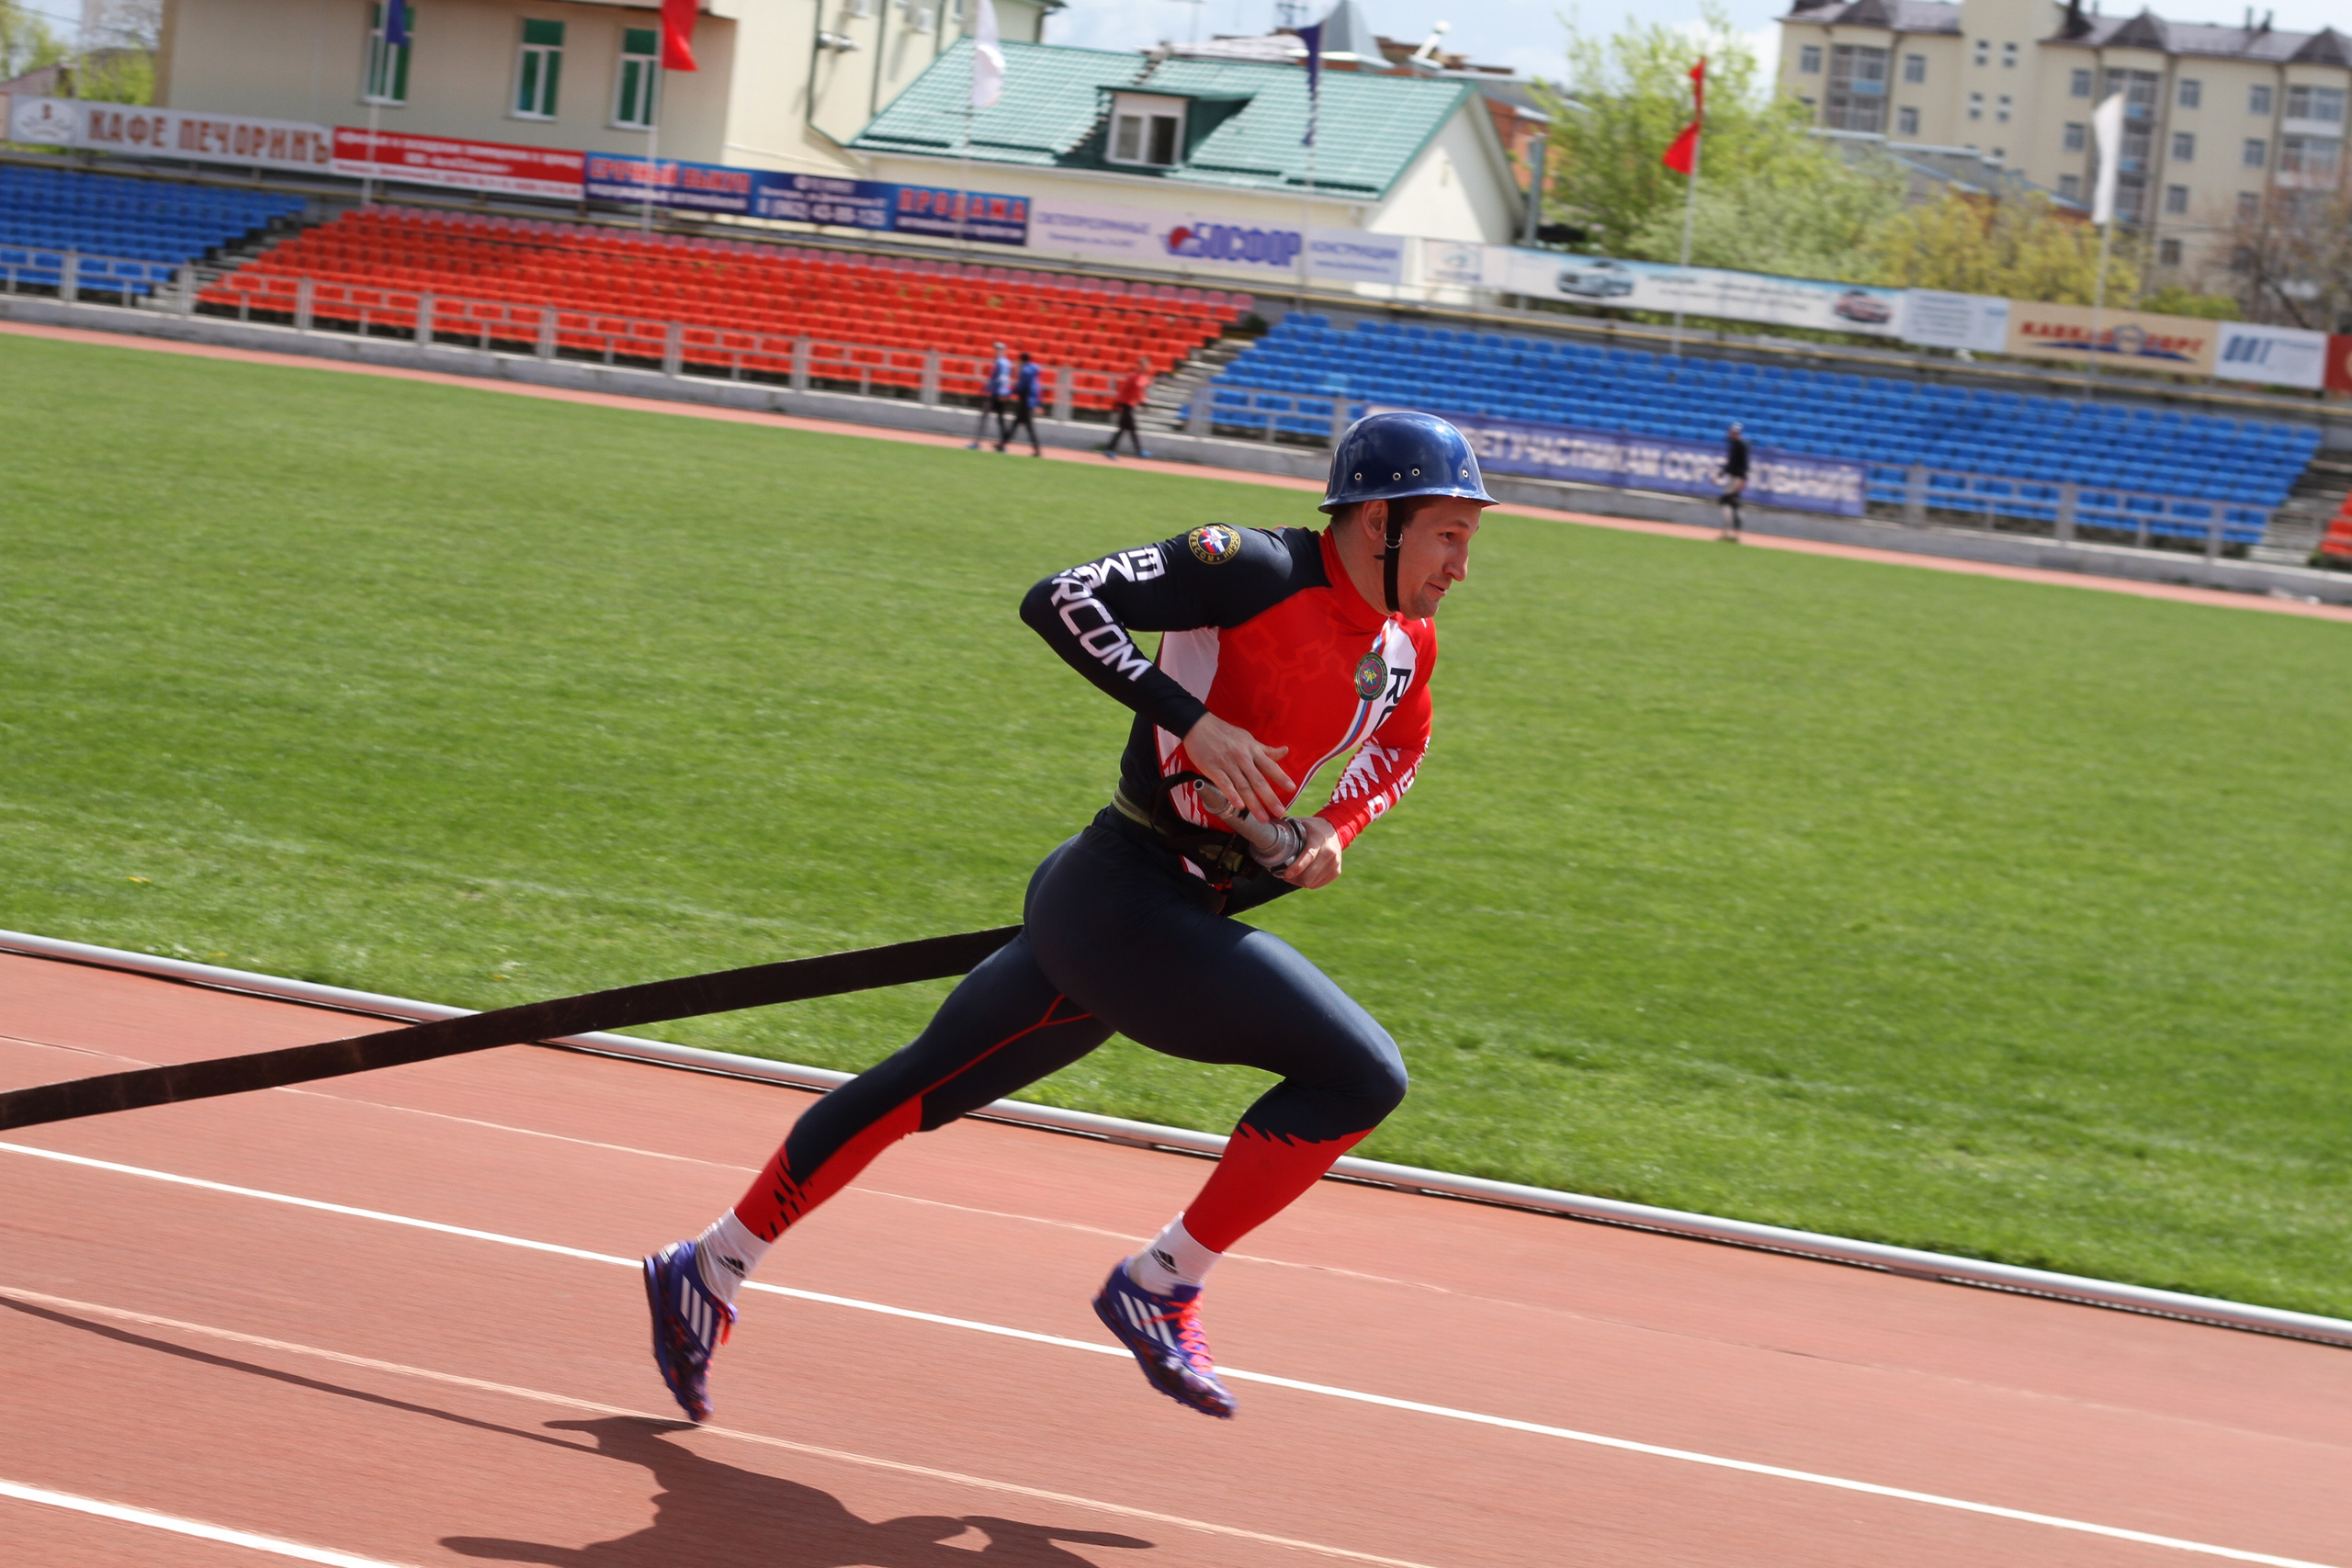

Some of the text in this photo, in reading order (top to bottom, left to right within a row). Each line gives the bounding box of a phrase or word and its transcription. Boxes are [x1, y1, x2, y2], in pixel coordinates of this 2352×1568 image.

[89, 108, 166, 147] КАФЕ
[178, 118, 330, 164] ПЕЧОРИНЪ
[898, 187, 1026, 222] ПРОДАЖА
